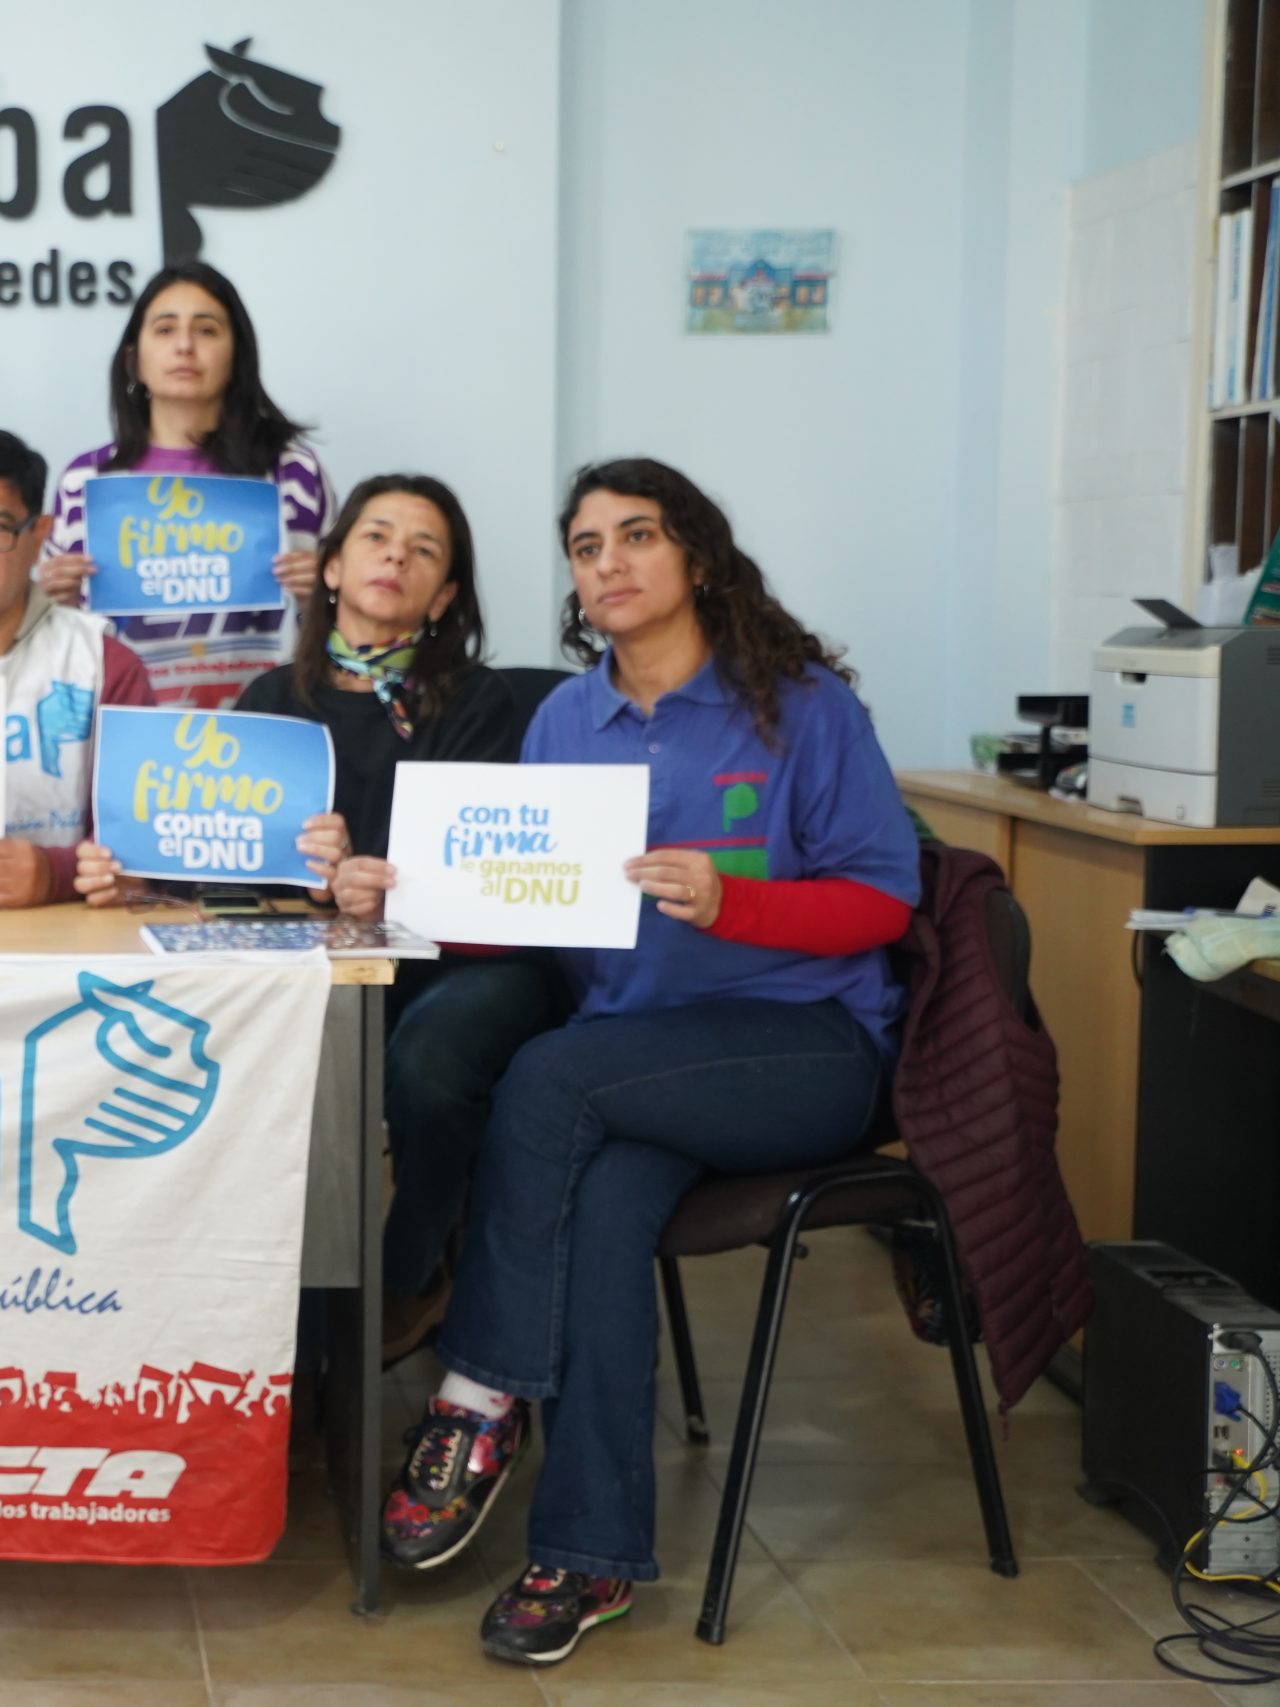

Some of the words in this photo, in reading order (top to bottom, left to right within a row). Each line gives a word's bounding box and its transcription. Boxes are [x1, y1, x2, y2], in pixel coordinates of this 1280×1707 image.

[119, 516, 245, 570] firmo
[137, 552, 230, 578] contra
[141, 576, 163, 596] el
[163, 577, 232, 604] DNU
[133, 759, 283, 823] firmo
[153, 810, 263, 840] contra
[458, 805, 511, 825] con
[519, 804, 550, 826] tu
[158, 834, 182, 857] el
[183, 839, 264, 872] DNU
[443, 825, 558, 867] firma
[480, 859, 583, 878] ganamos
[480, 875, 502, 897] al
[503, 878, 580, 906] DNU
[30, 1501, 171, 1526] trabajadores
